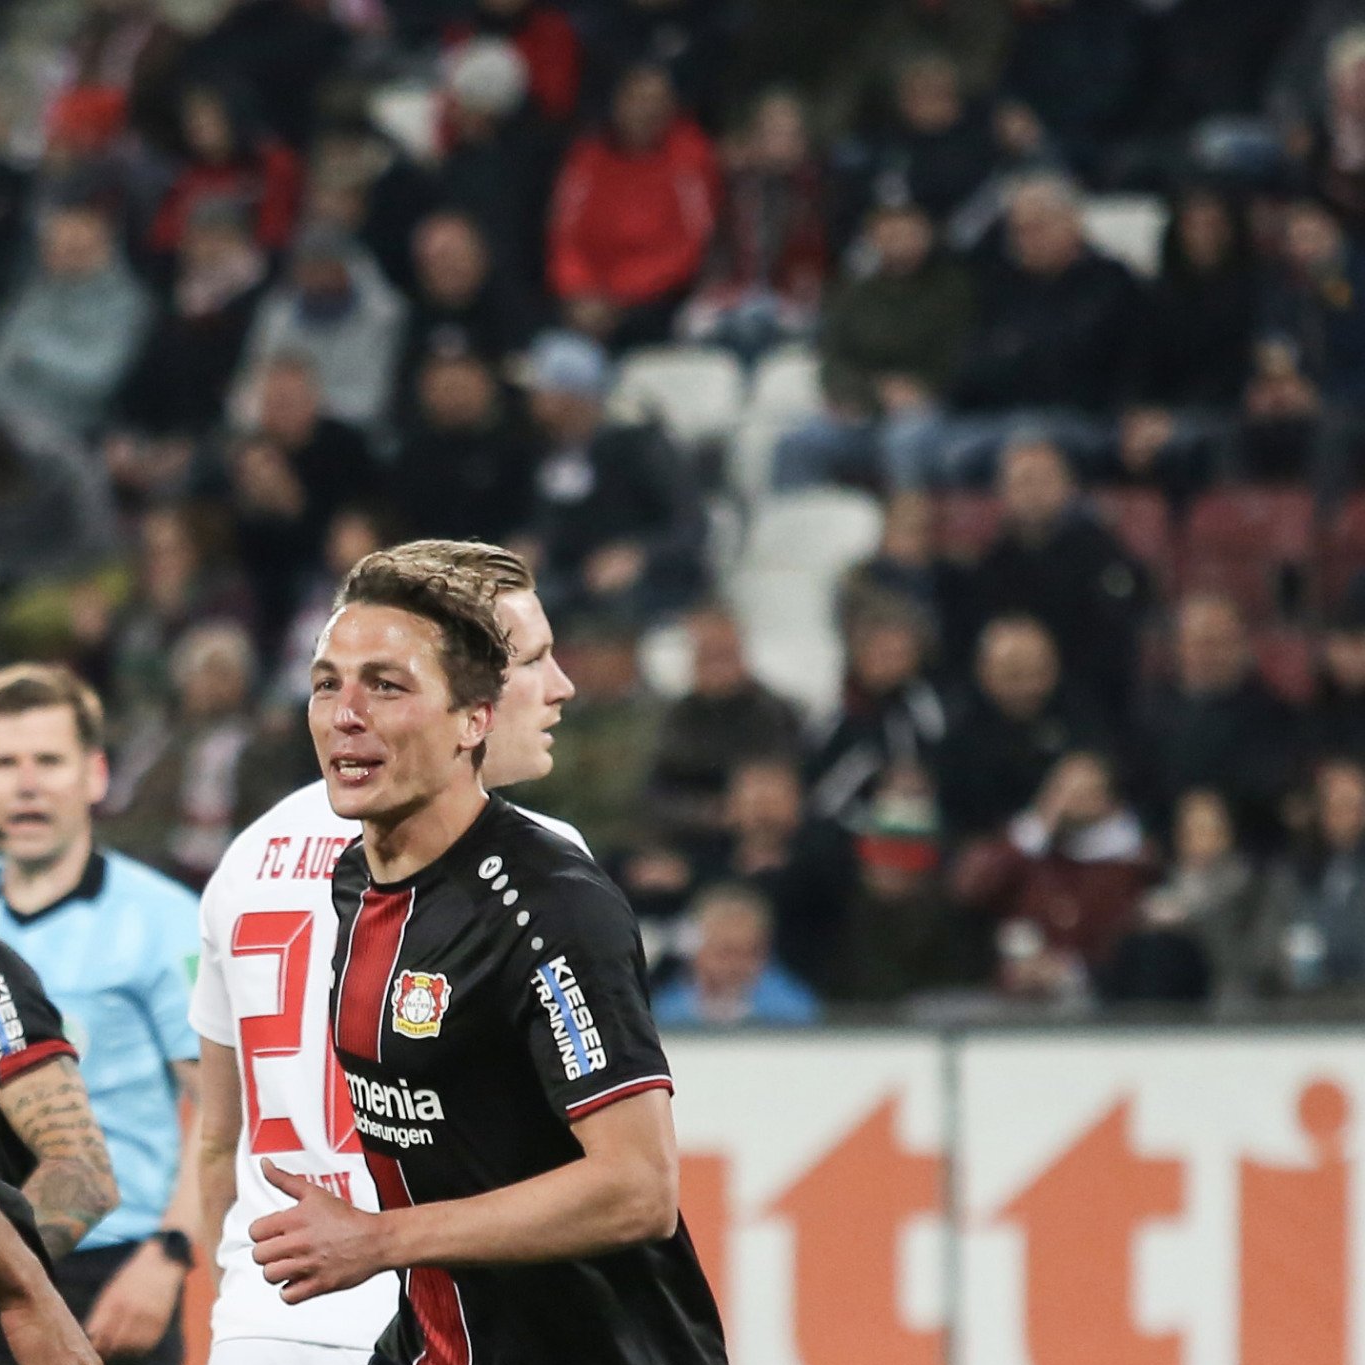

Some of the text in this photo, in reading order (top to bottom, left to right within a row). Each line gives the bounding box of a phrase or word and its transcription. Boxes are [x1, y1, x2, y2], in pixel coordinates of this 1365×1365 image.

[256, 836, 352, 880] FC AUG
[530, 968, 583, 1081] TRAINING
[548, 955, 608, 1073] KIESER
[344, 1071, 445, 1121] menia
